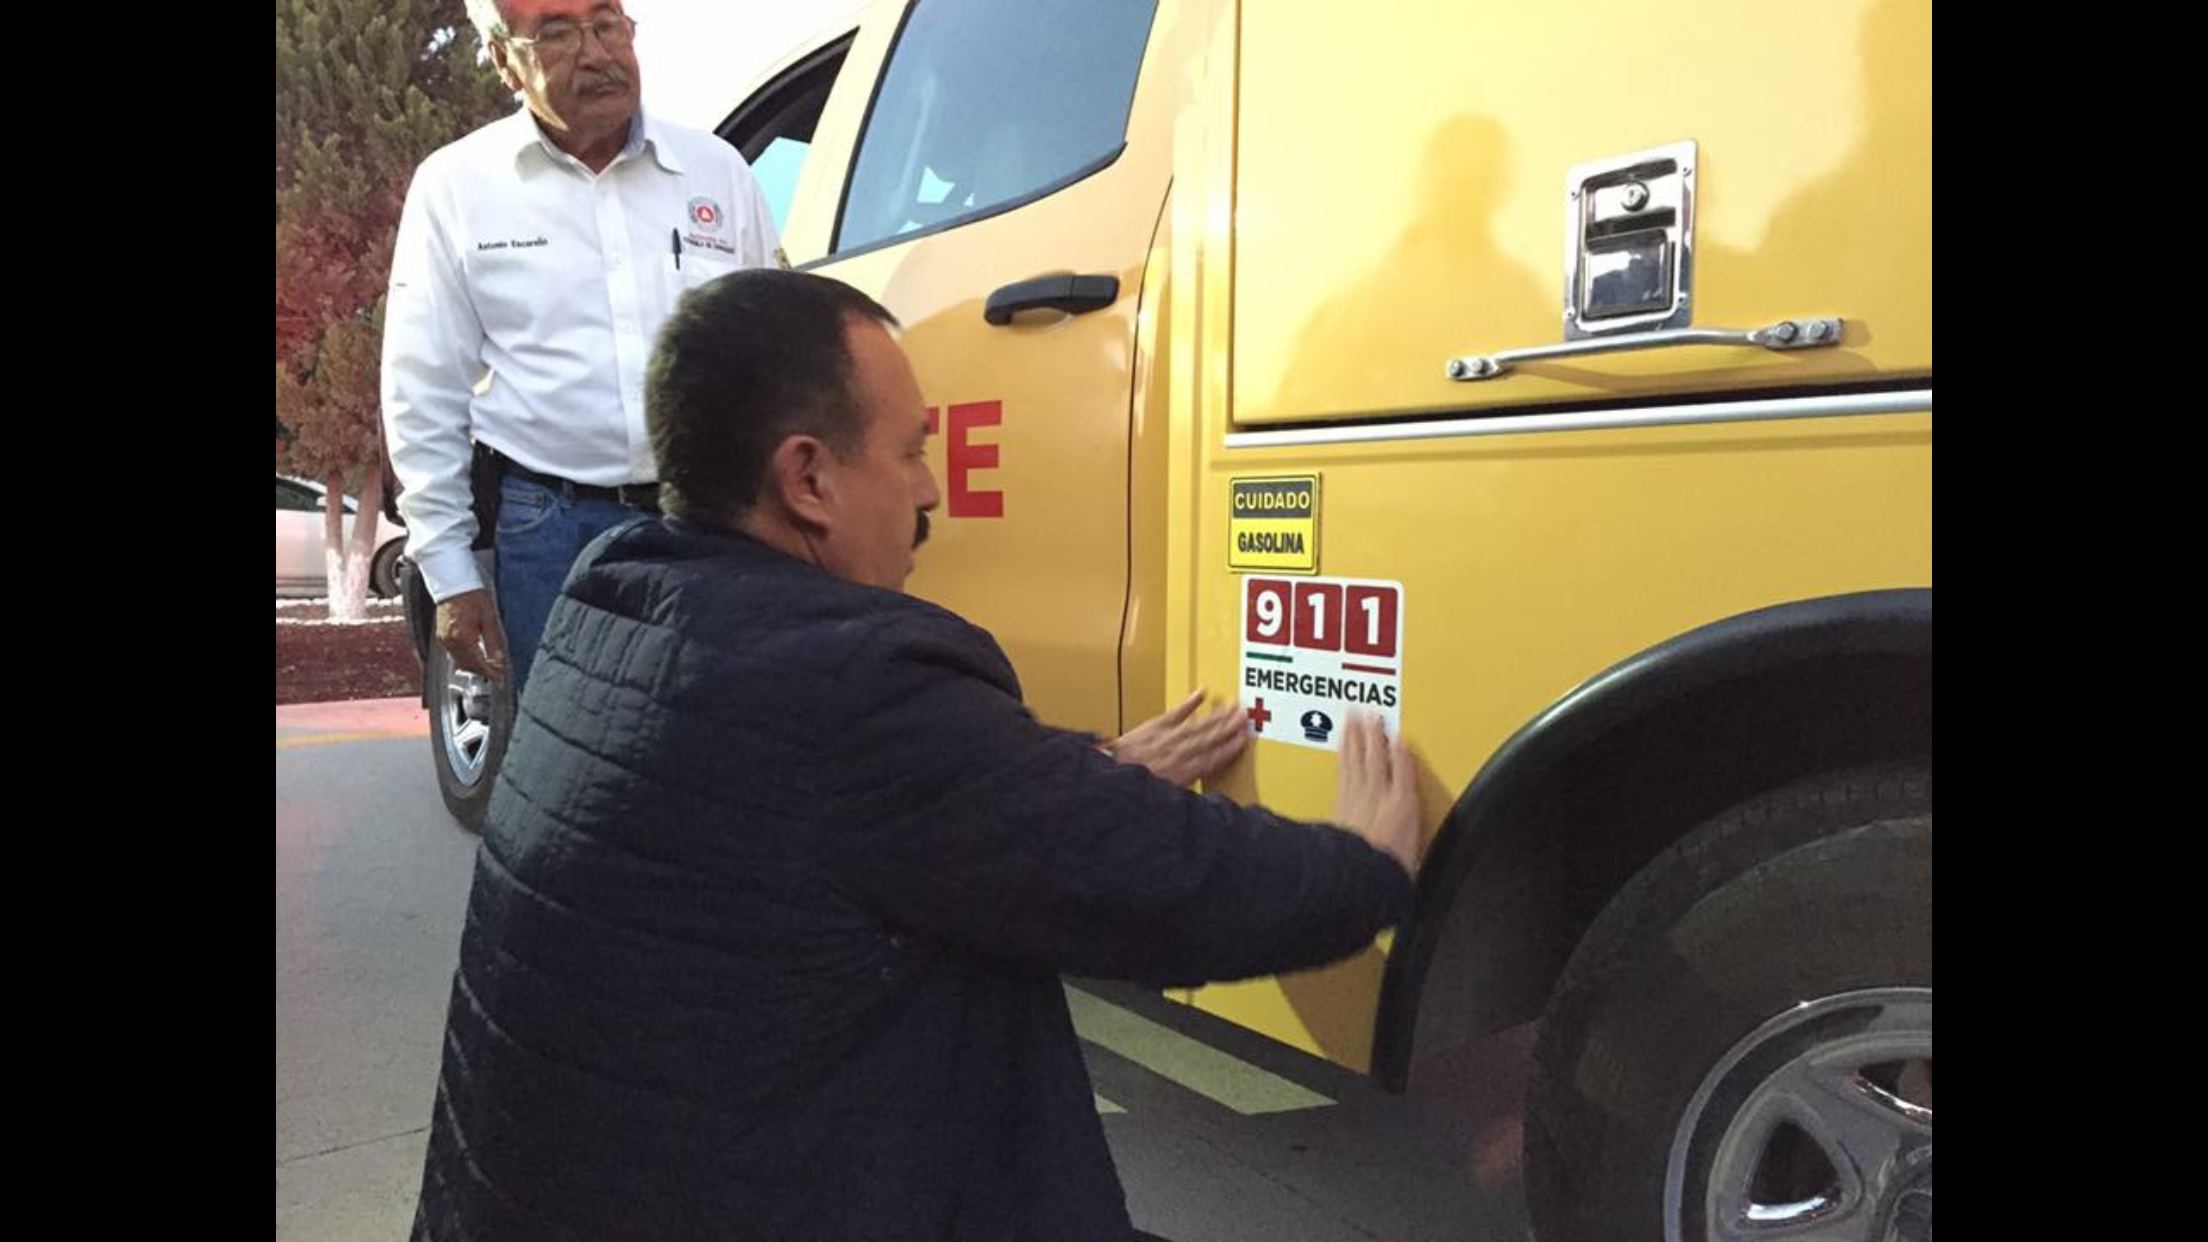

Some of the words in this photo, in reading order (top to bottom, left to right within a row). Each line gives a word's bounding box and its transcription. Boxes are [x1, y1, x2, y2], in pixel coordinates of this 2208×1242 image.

[1234, 491, 1310, 510] CUIDADO
[1237, 531, 1305, 554] GASOLINA
[1255, 589, 1381, 646] 911
[1244, 666, 1397, 708] EMERGENCIAS
